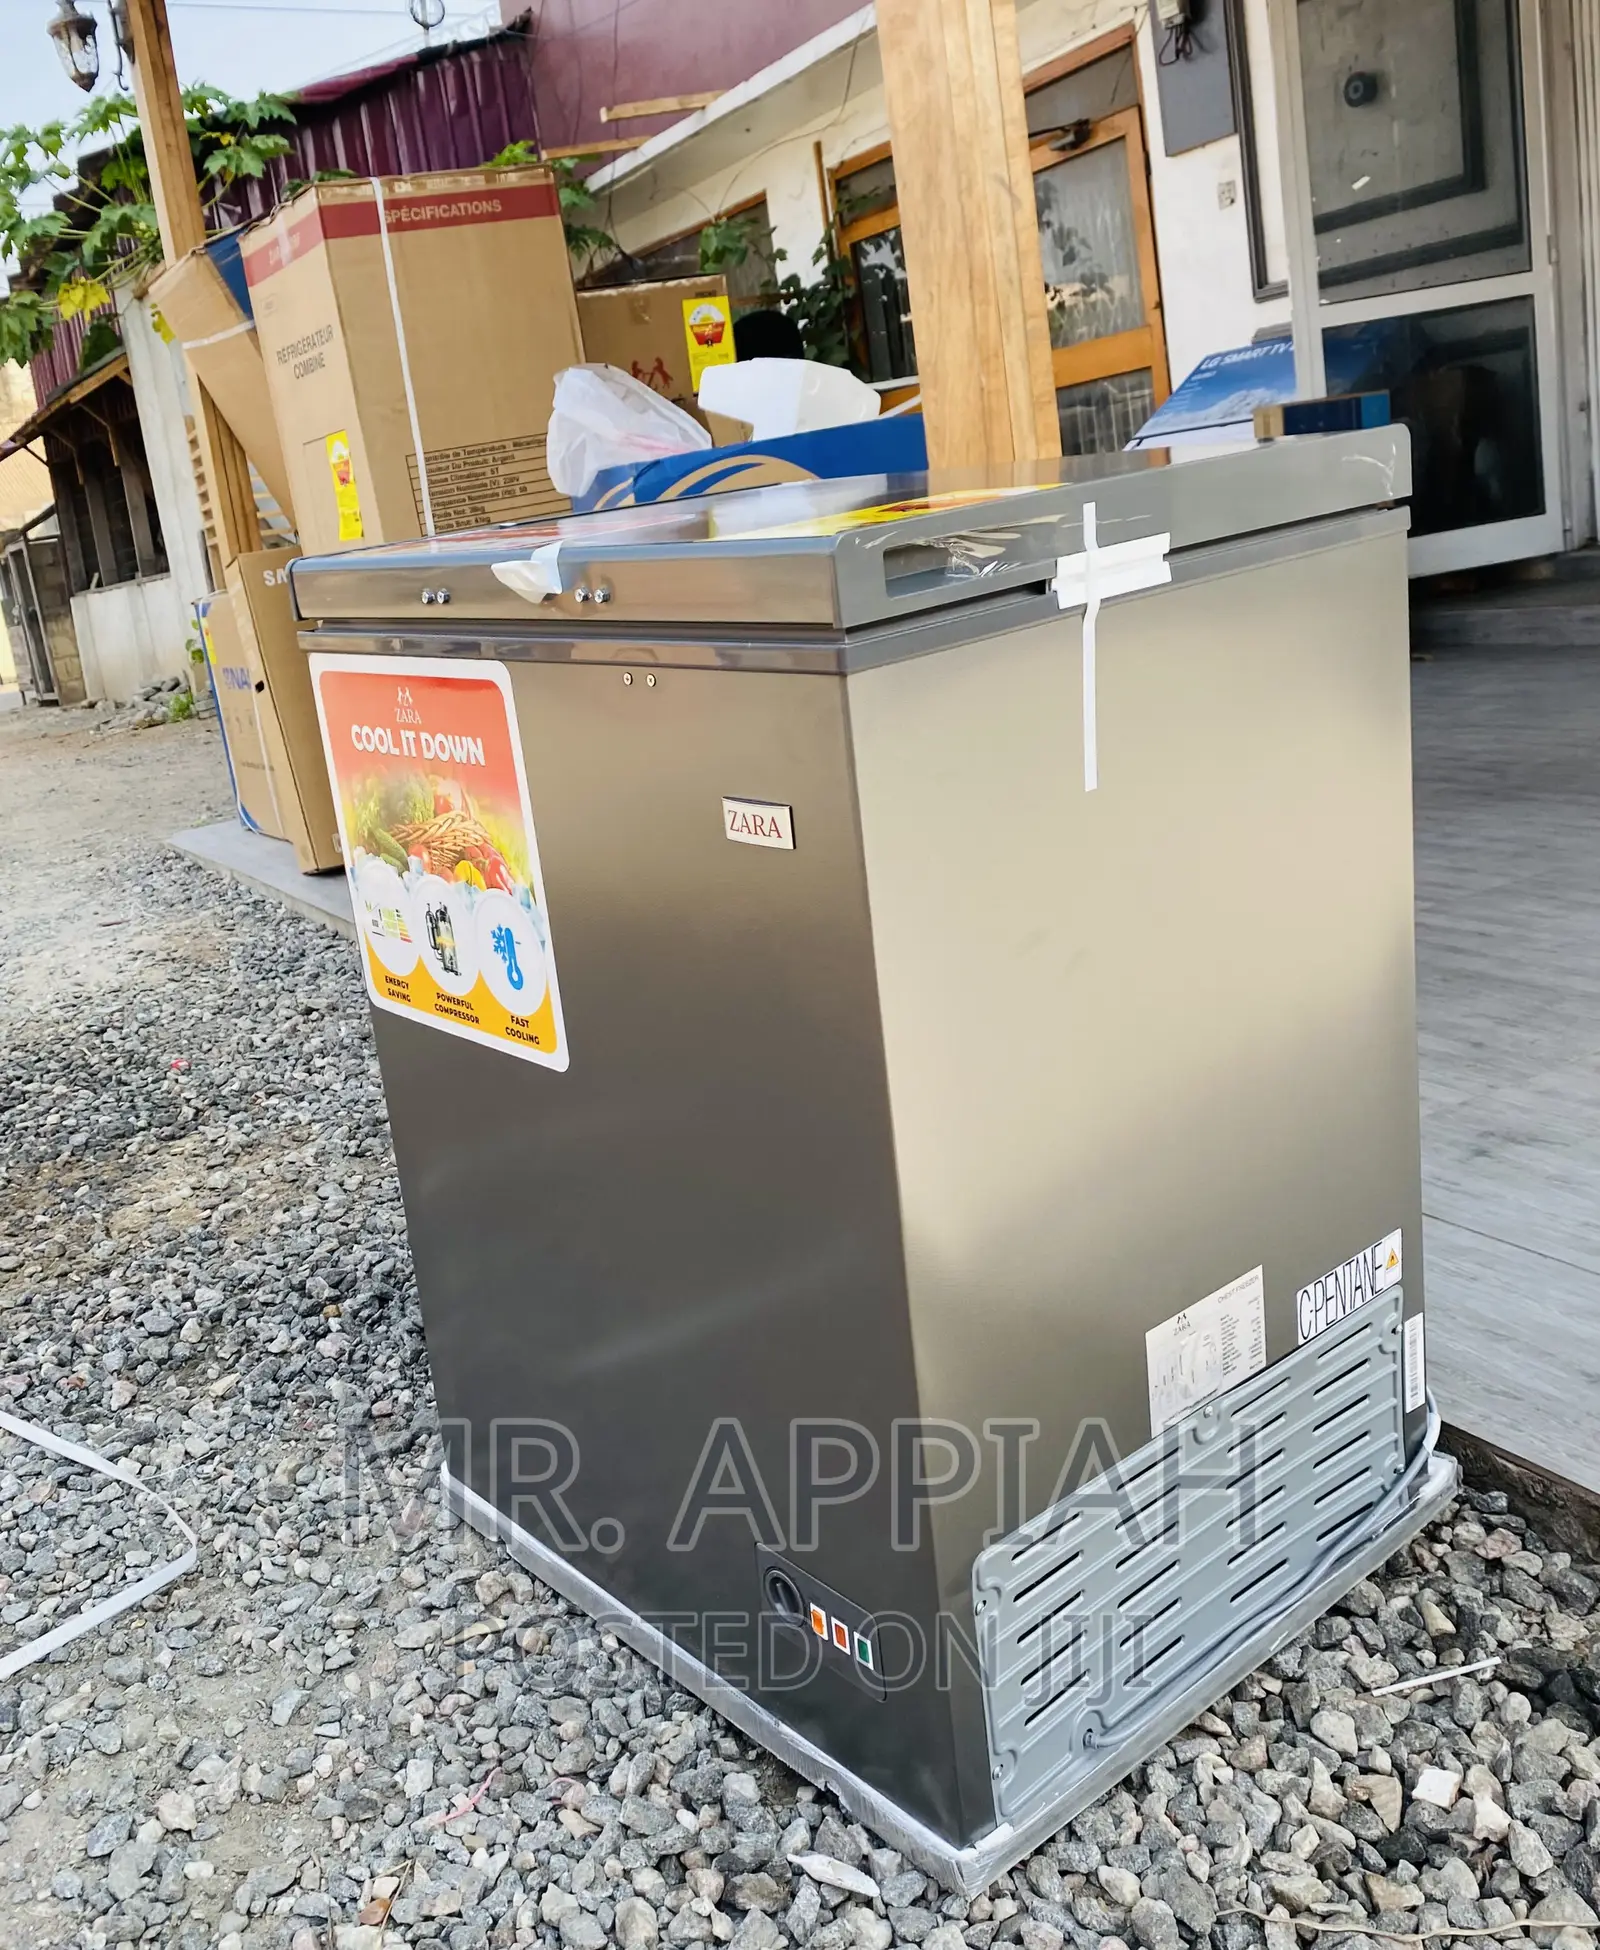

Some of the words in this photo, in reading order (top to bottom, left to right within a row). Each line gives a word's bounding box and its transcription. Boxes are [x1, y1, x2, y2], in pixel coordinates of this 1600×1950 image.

[384, 199, 502, 224] SPÉCIFICATIONS
[1200, 356, 1221, 370] LG
[1220, 346, 1270, 366] SMART
[1269, 342, 1289, 356] TV
[394, 708, 422, 725] ZARA
[351, 724, 400, 756] COOL
[400, 729, 417, 758] IT
[420, 731, 486, 767] DOWN
[728, 809, 783, 839] ZARA
[385, 975, 409, 990] ENERGY
[387, 988, 411, 1003] SAVING
[436, 992, 474, 1011] POWERFUL
[434, 1003, 480, 1025] COMPRESSOR
[510, 1015, 529, 1029] FAST
[505, 1026, 540, 1045] COOLING
[1299, 1241, 1384, 1341] C-PENTANE
